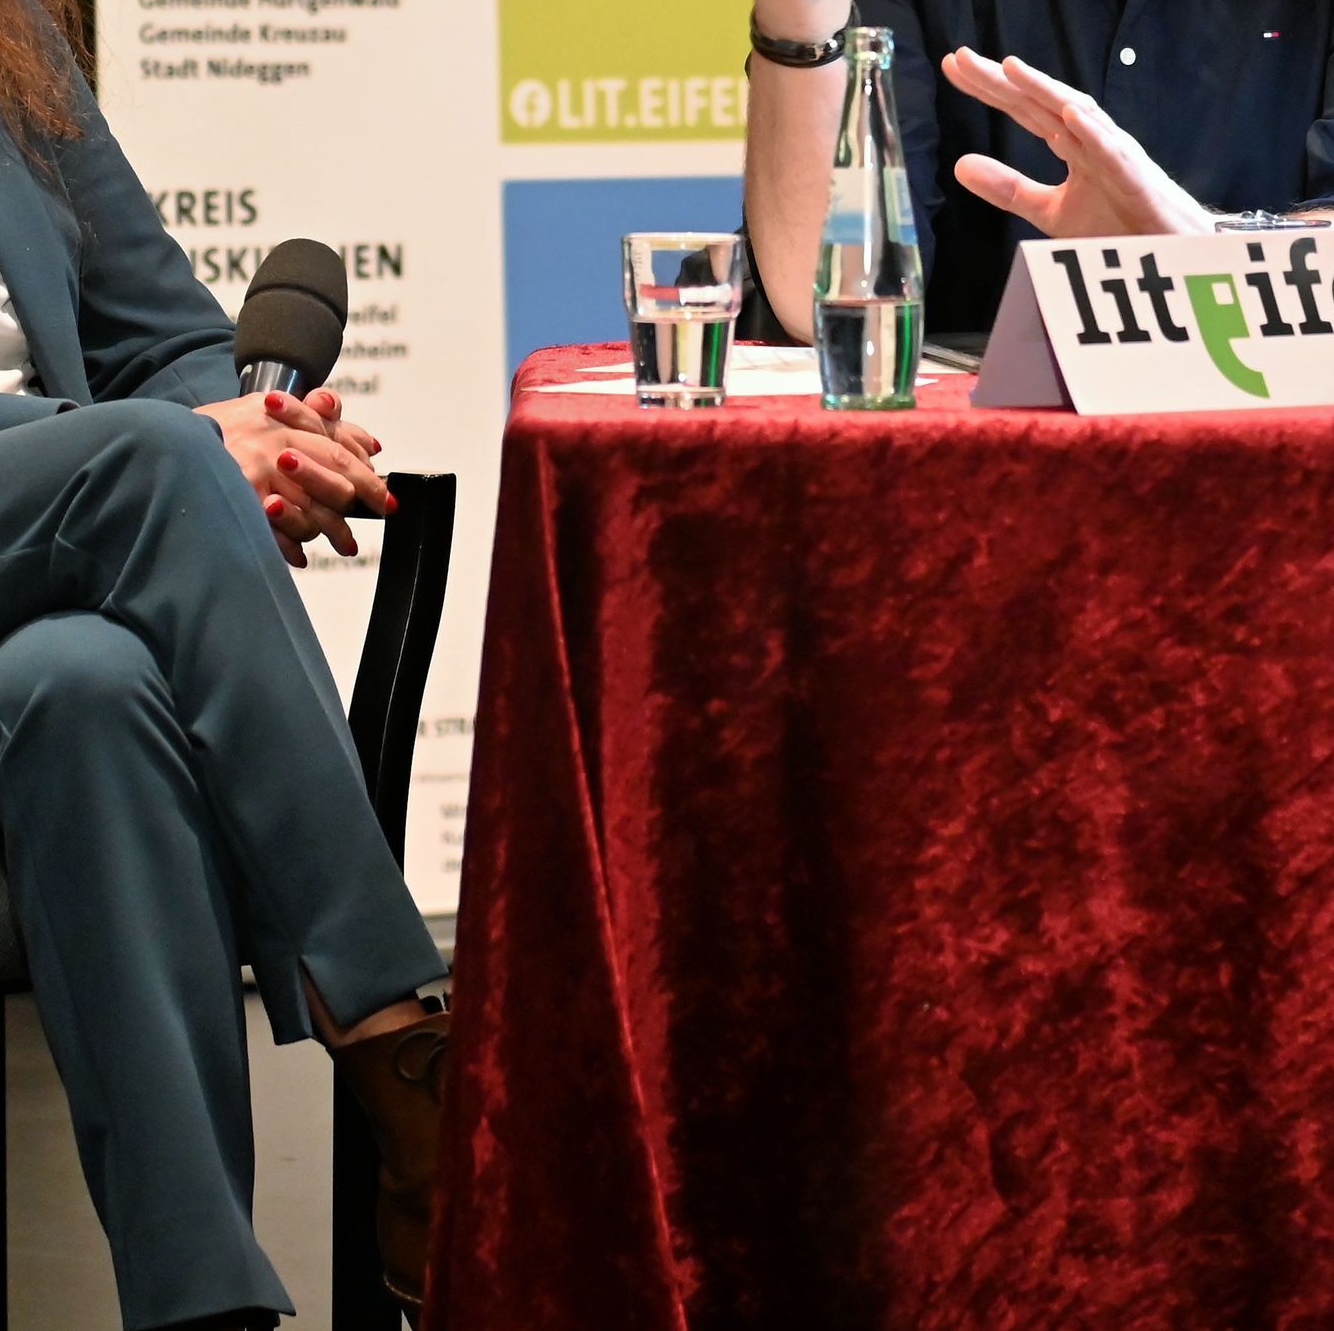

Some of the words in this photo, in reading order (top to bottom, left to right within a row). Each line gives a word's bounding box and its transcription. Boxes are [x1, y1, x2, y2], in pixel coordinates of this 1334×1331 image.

[139, 23, 251, 44] Gemeinde
[259, 25, 347, 43] Kreuzau
[140, 59, 198, 80] Stadt
[207, 60, 310, 84] Nideggen
